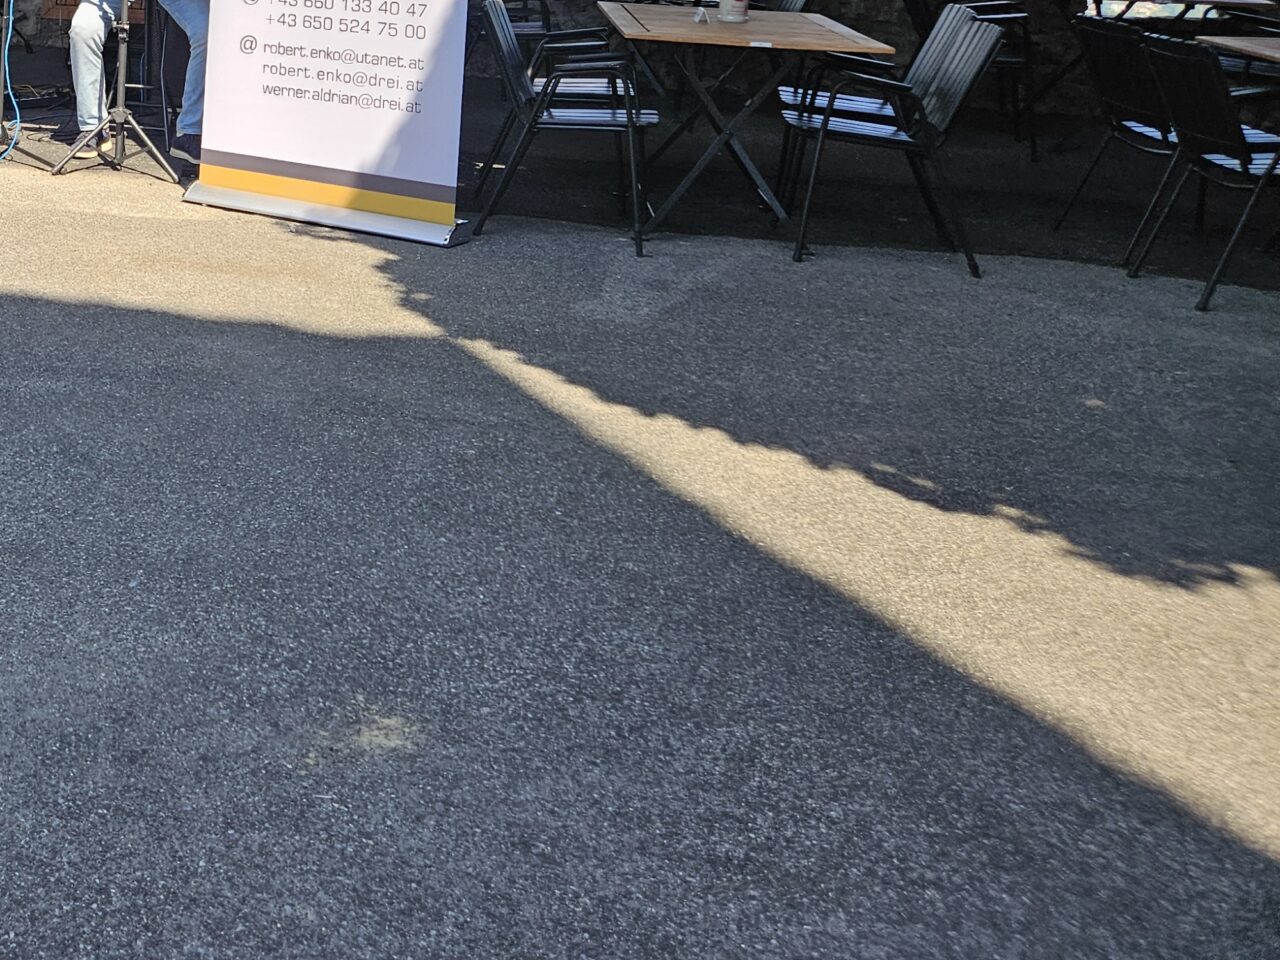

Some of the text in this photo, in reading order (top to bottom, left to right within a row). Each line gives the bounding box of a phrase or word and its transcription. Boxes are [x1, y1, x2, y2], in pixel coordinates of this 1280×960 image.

[378, 1, 400, 16] 40
[406, 3, 428, 18] 47
[265, 13, 426, 40] +43 650 524 75 00
[263, 40, 425, 71] robert.enko@utanet.at
[262, 62, 424, 93] robert.enko@drei.at
[262, 83, 422, 114] werner.aldrian@drei.at
